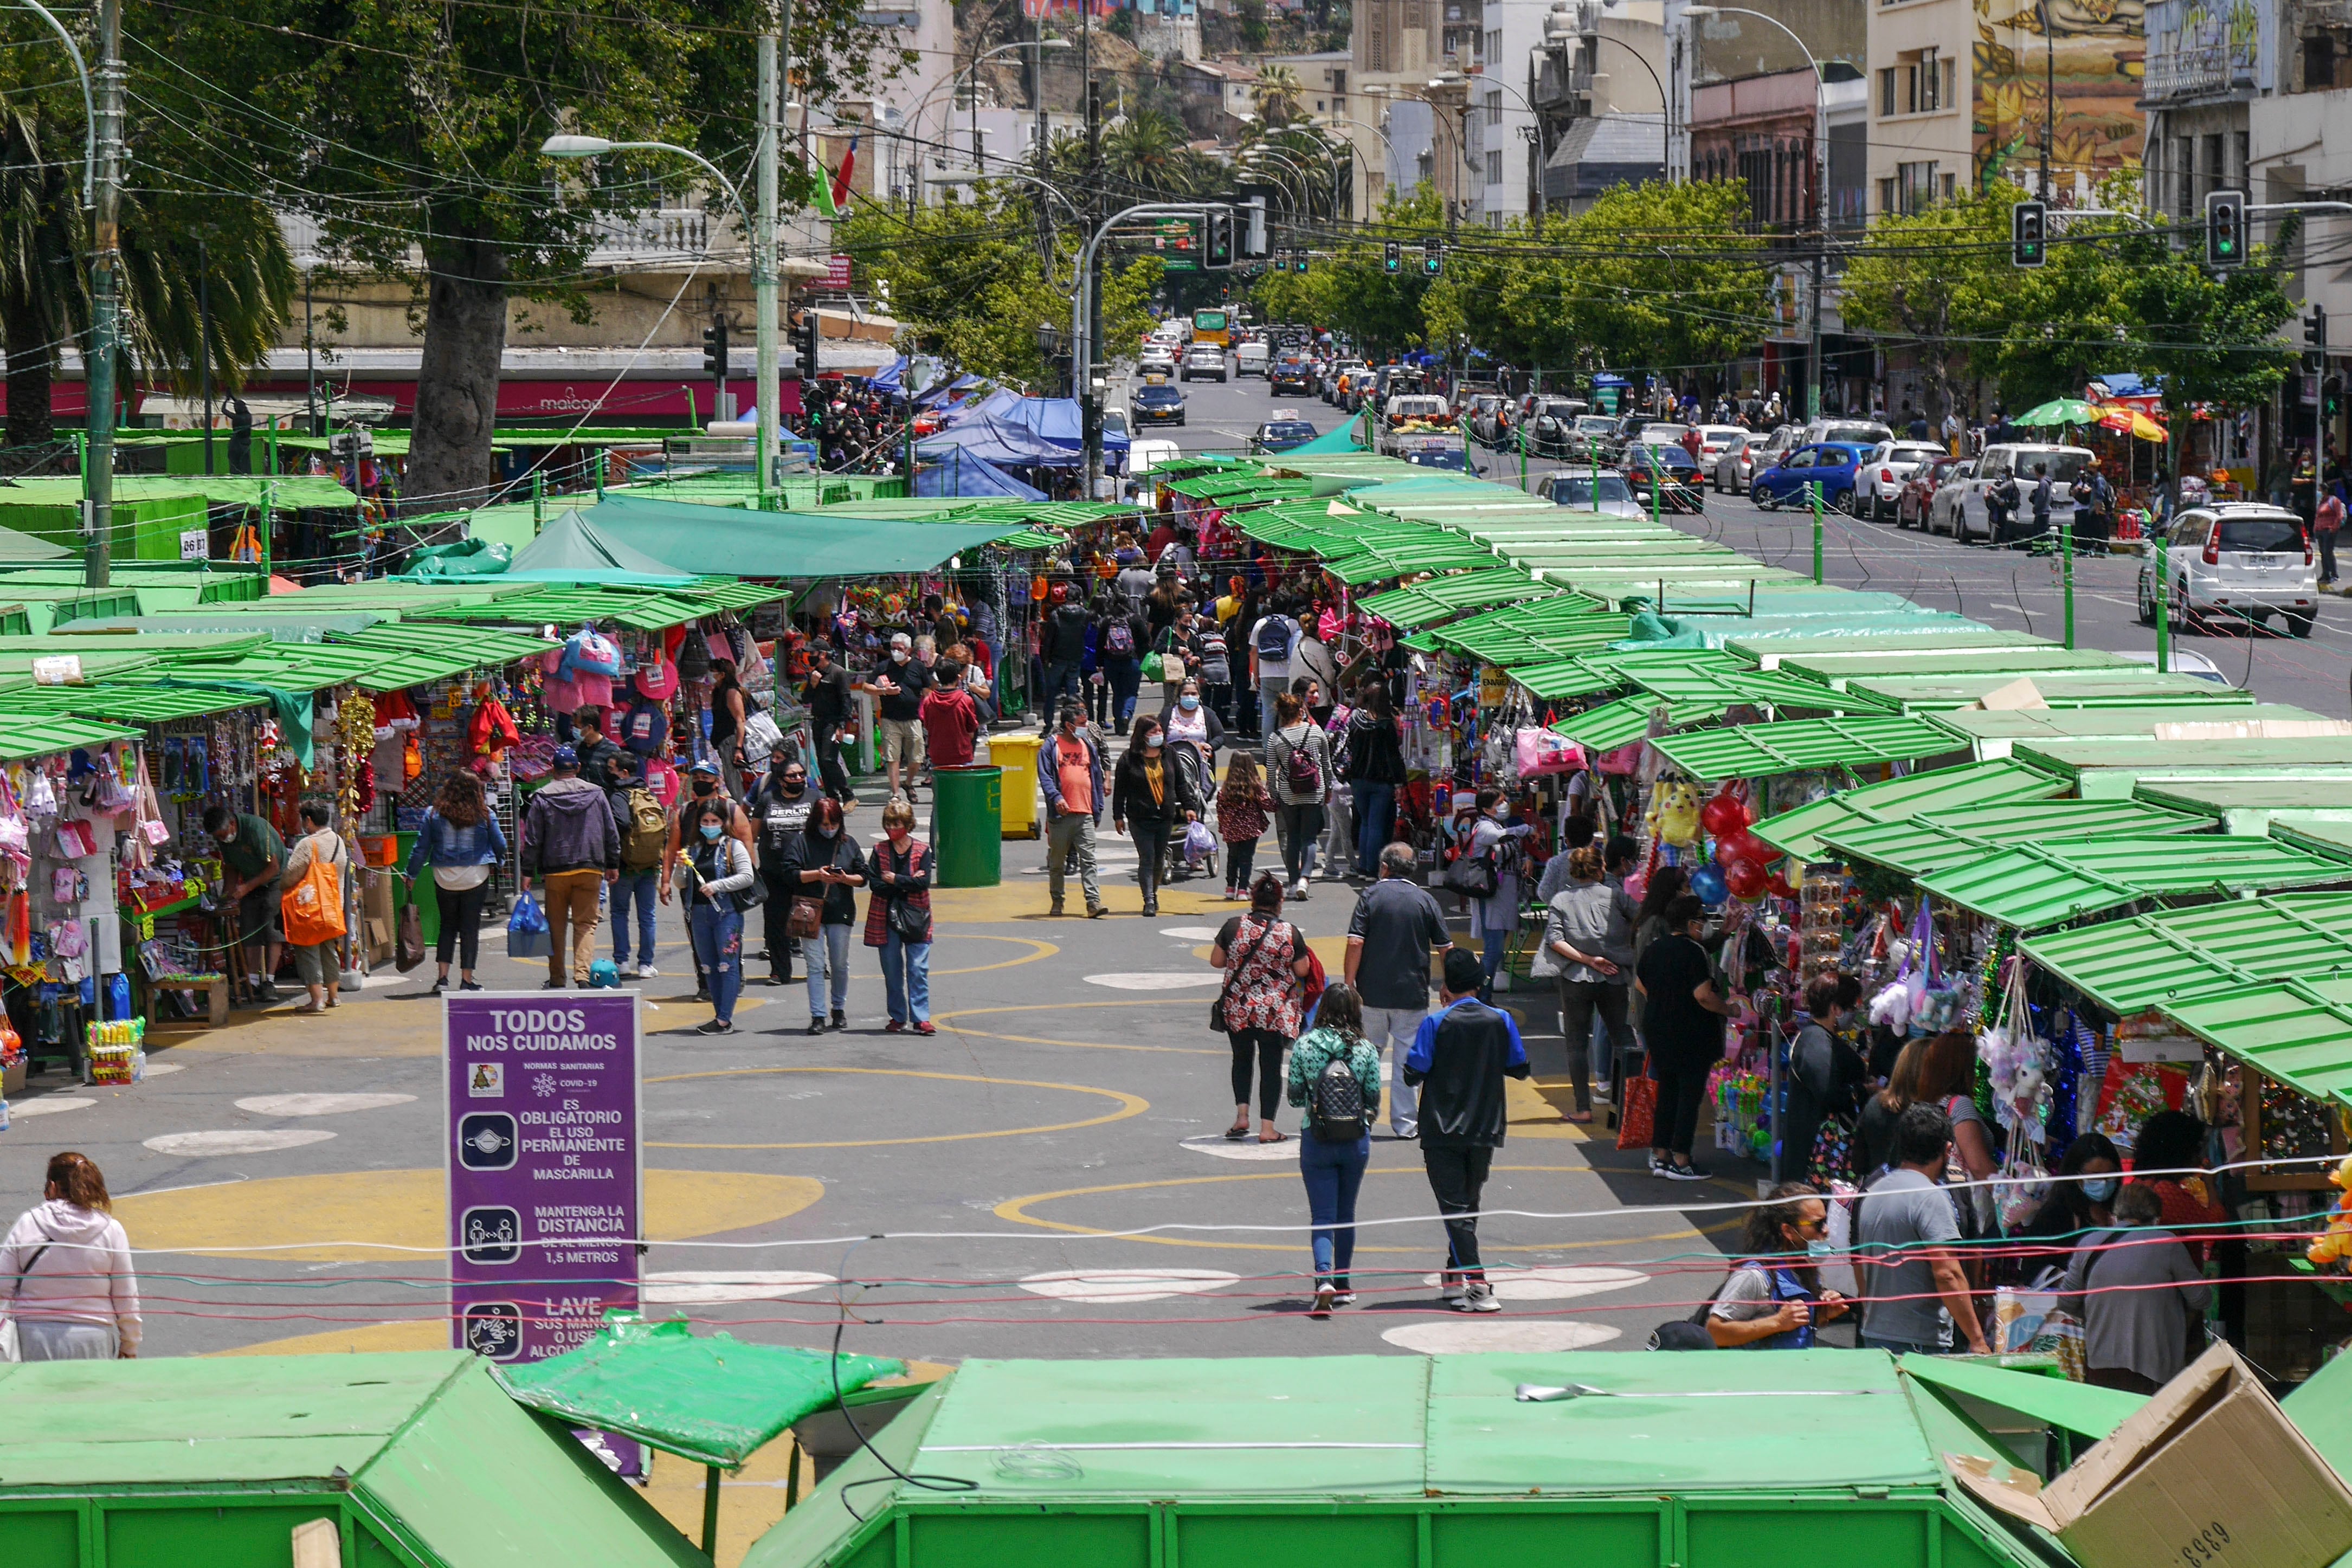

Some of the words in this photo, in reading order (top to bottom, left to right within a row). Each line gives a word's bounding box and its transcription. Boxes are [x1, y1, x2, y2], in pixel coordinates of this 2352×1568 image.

[770, 807, 810, 816] BERLIN
[489, 1010, 585, 1033] TODOS
[467, 1035, 508, 1051] NOS
[513, 1034, 617, 1051] CUIDAMOS
[563, 1099, 580, 1110] ES
[520, 1111, 622, 1125] OBLIGATORIO
[549, 1127, 565, 1138] EL
[566, 1126, 595, 1138] USO
[521, 1139, 626, 1152] PERMANENTE
[563, 1154, 581, 1166] DE
[533, 1167, 614, 1180] MASCARILLA
[534, 1205, 605, 1217] MANTENGA
[608, 1205, 624, 1216] LA
[537, 1218, 625, 1233] DISTANCIA
[577, 1236, 622, 1248] MENOS
[544, 1251, 564, 1264] 1,5
[565, 1251, 619, 1263] METROS
[545, 1296, 602, 1316] LAVE
[533, 1317, 564, 1330] SUS
[553, 1331, 565, 1344] O
